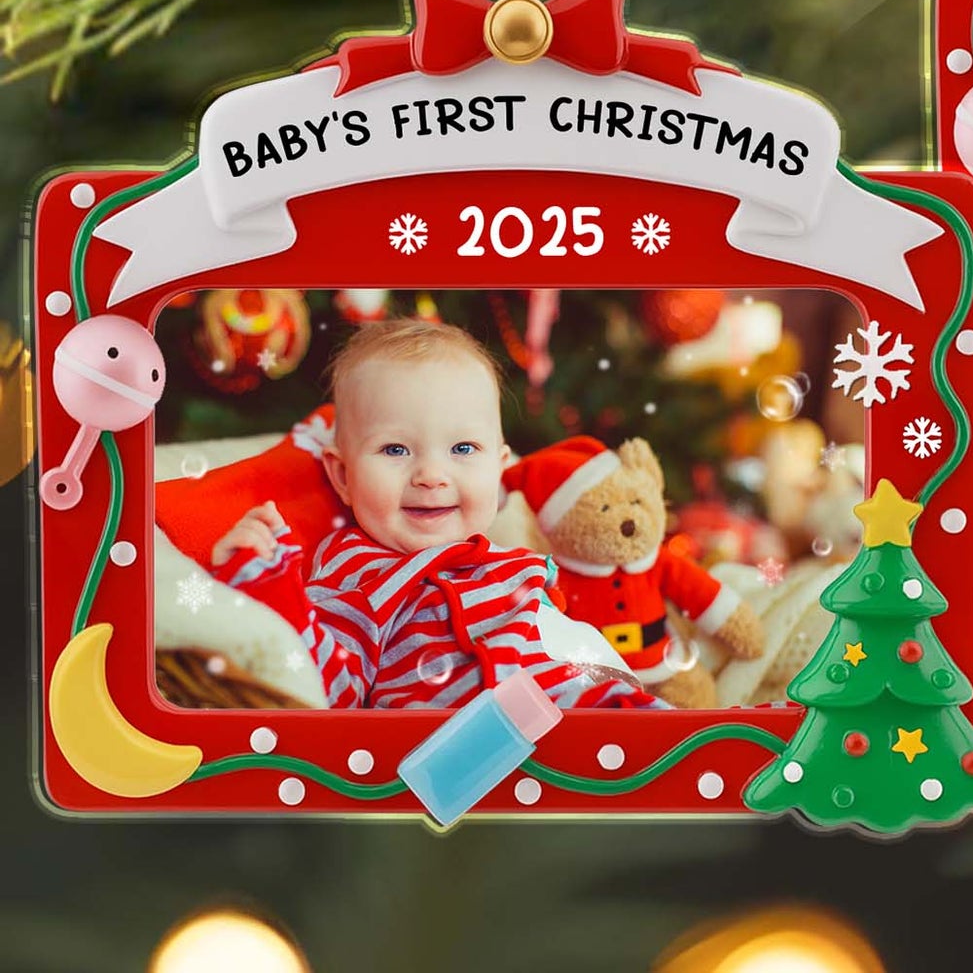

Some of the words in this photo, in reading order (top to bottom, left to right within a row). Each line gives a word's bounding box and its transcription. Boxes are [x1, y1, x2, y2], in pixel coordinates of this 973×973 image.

[222, 110, 371, 178] BABY'S
[391, 95, 527, 139] FIRST
[549, 96, 809, 176] CHRISTMAS
[457, 205, 604, 258] 2025
